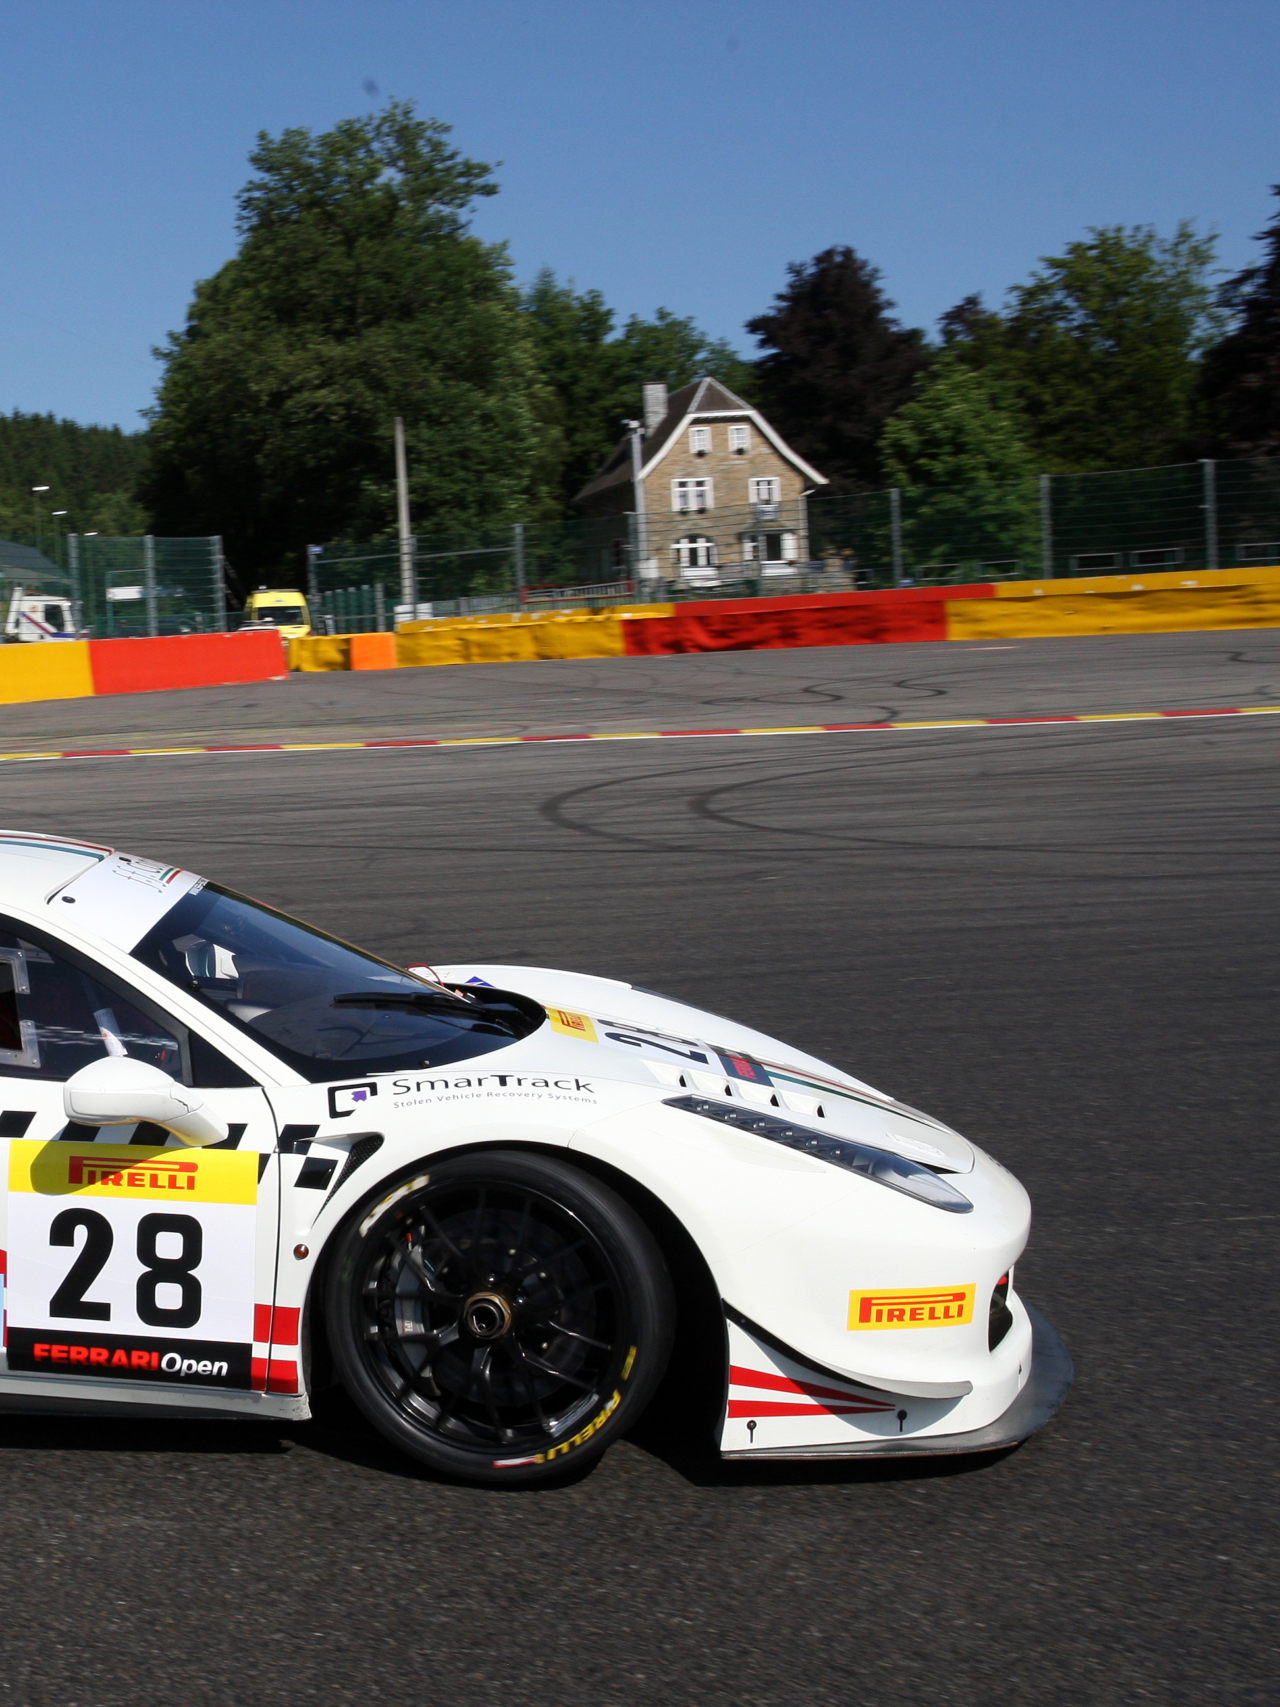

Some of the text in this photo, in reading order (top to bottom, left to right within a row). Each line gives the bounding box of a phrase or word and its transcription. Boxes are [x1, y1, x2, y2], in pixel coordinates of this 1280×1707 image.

[393, 1090, 599, 1110] Stolen Vehicle Recovery Systems
[68, 1155, 199, 1191] PIRELLI
[48, 1207, 203, 1329] 28
[858, 1291, 967, 1324] PIRELLI
